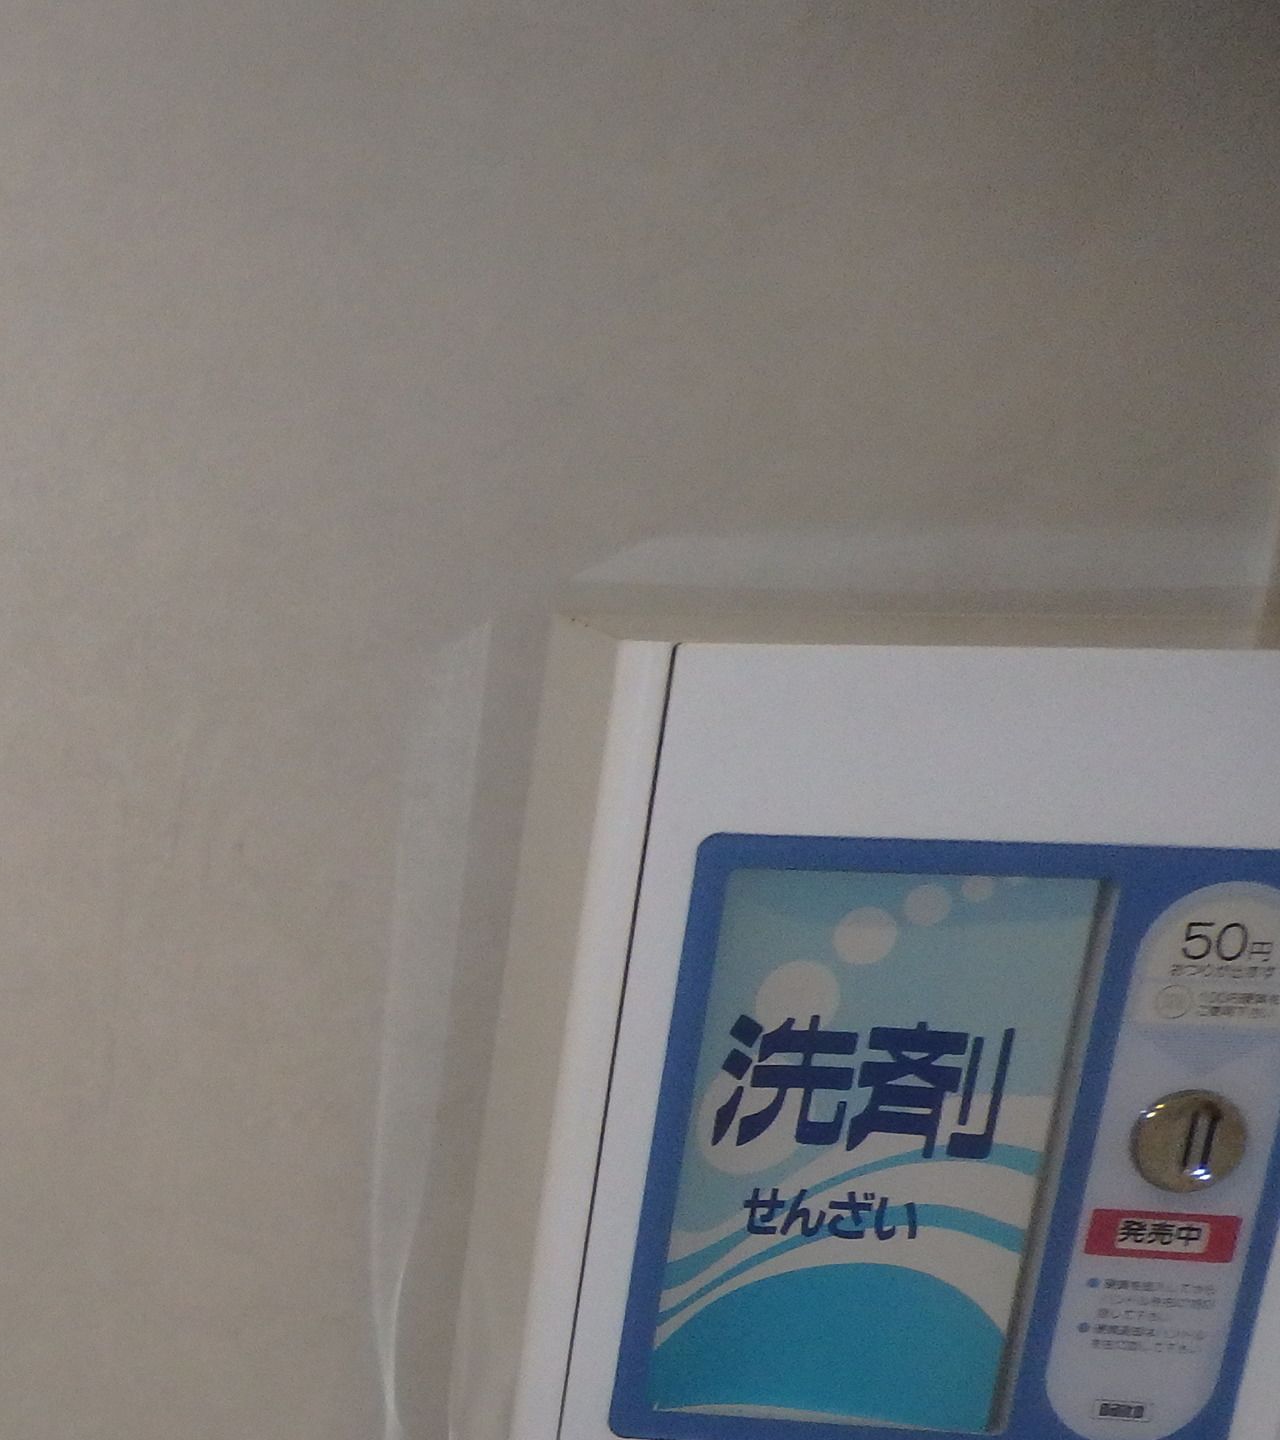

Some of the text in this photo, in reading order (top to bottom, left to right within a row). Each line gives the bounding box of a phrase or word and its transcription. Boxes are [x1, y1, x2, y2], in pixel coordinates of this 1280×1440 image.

[1182, 922, 1273, 962] 50円
[712, 1015, 1016, 1159] 洗剤
[743, 1187, 918, 1240] せんざい
[1118, 1219, 1203, 1247] 発売中
